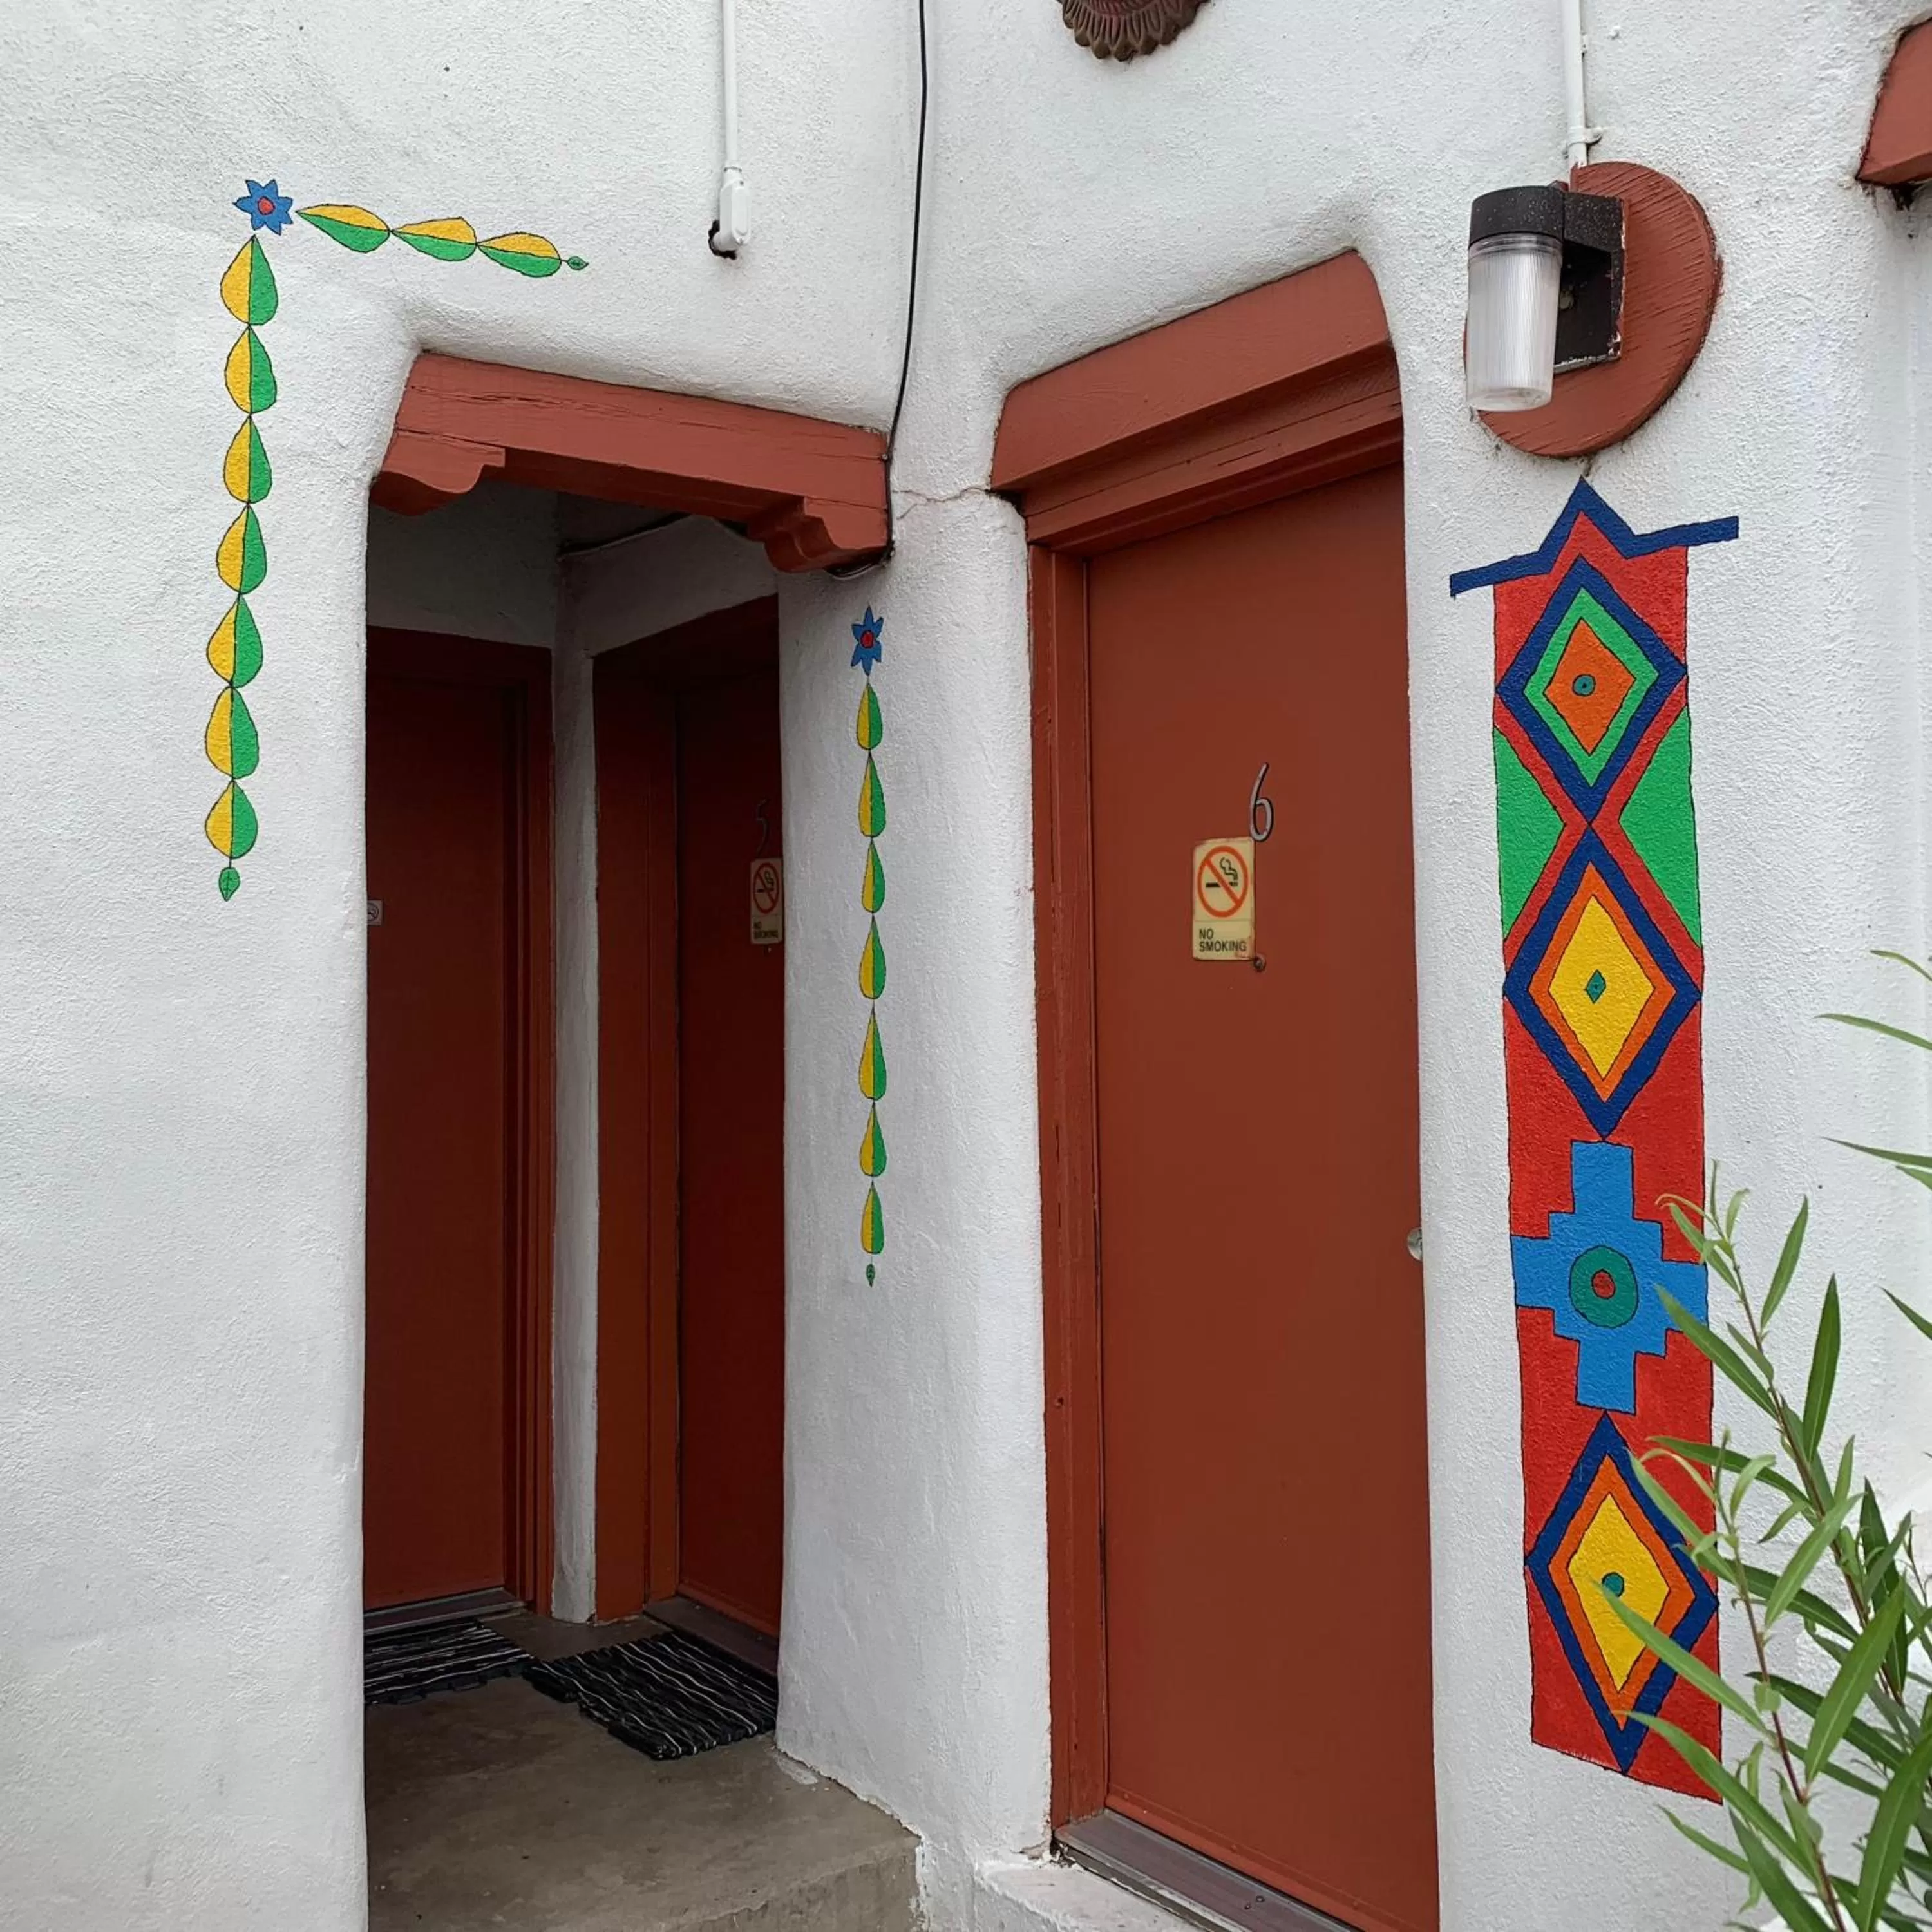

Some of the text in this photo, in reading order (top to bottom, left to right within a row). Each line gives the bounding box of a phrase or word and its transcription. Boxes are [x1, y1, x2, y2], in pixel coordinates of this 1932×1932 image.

[1250, 762, 1274, 842] 6
[755, 798, 769, 857] 5
[1199, 929, 1214, 940] NO
[1199, 940, 1247, 952] SMOKING
